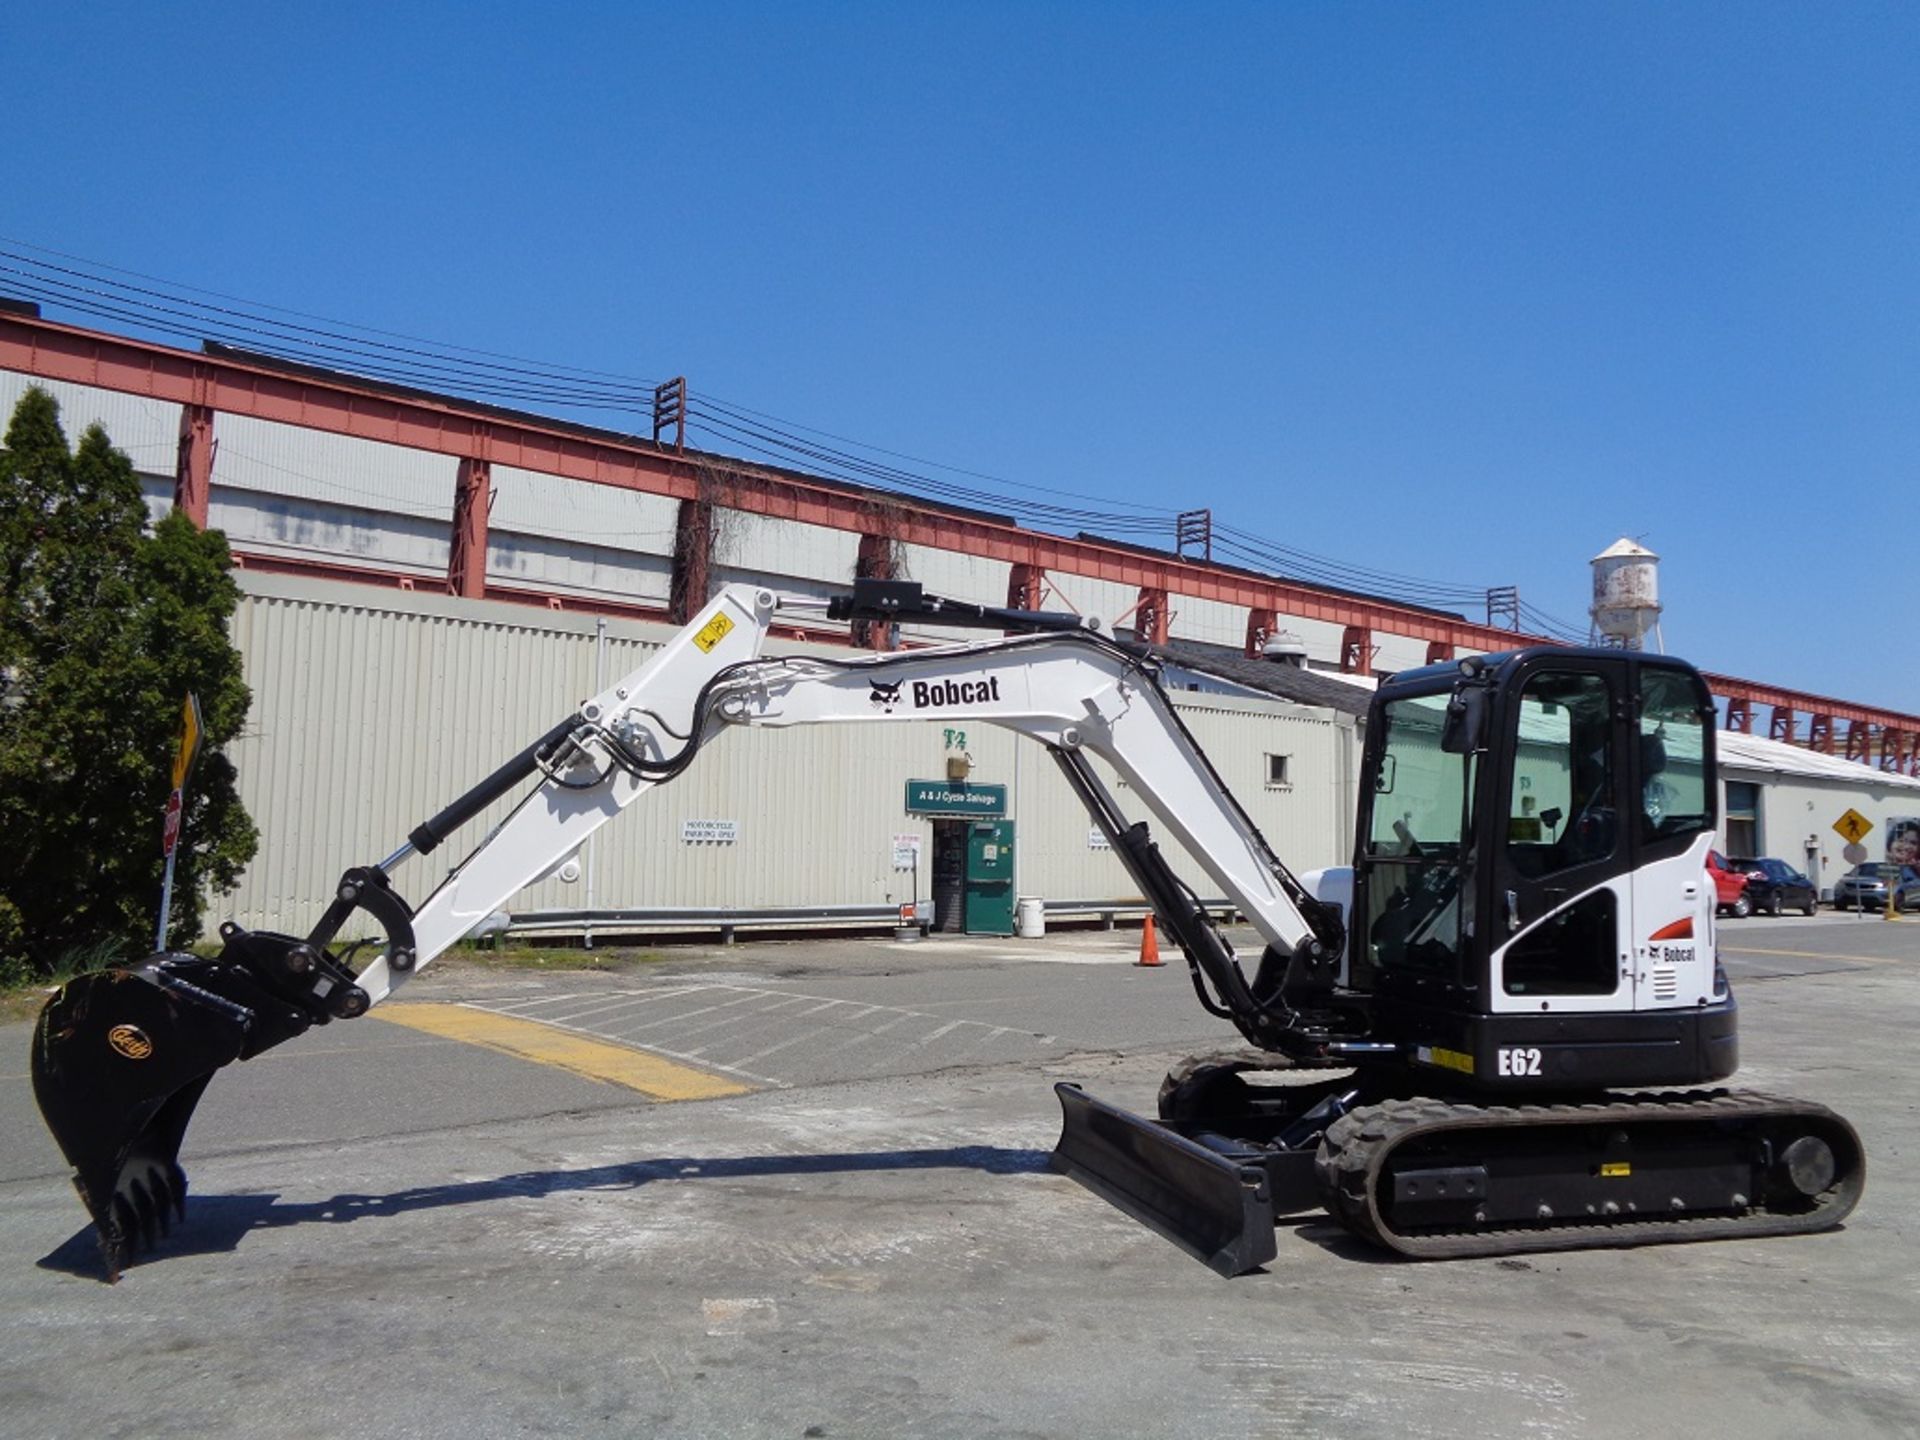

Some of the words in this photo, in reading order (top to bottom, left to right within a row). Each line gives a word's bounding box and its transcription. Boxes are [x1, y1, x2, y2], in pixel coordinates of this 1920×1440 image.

[912, 676, 1000, 708] Bobcat
[919, 791, 927, 801] A
[927, 791, 934, 801] &
[935, 791, 942, 801] J
[942, 791, 966, 804] Cycle
[966, 793, 997, 806] Salvage
[686, 820, 735, 830] MOTORCYCLE
[1664, 946, 1695, 962] Bobcat
[1498, 1048, 1542, 1076] E62
